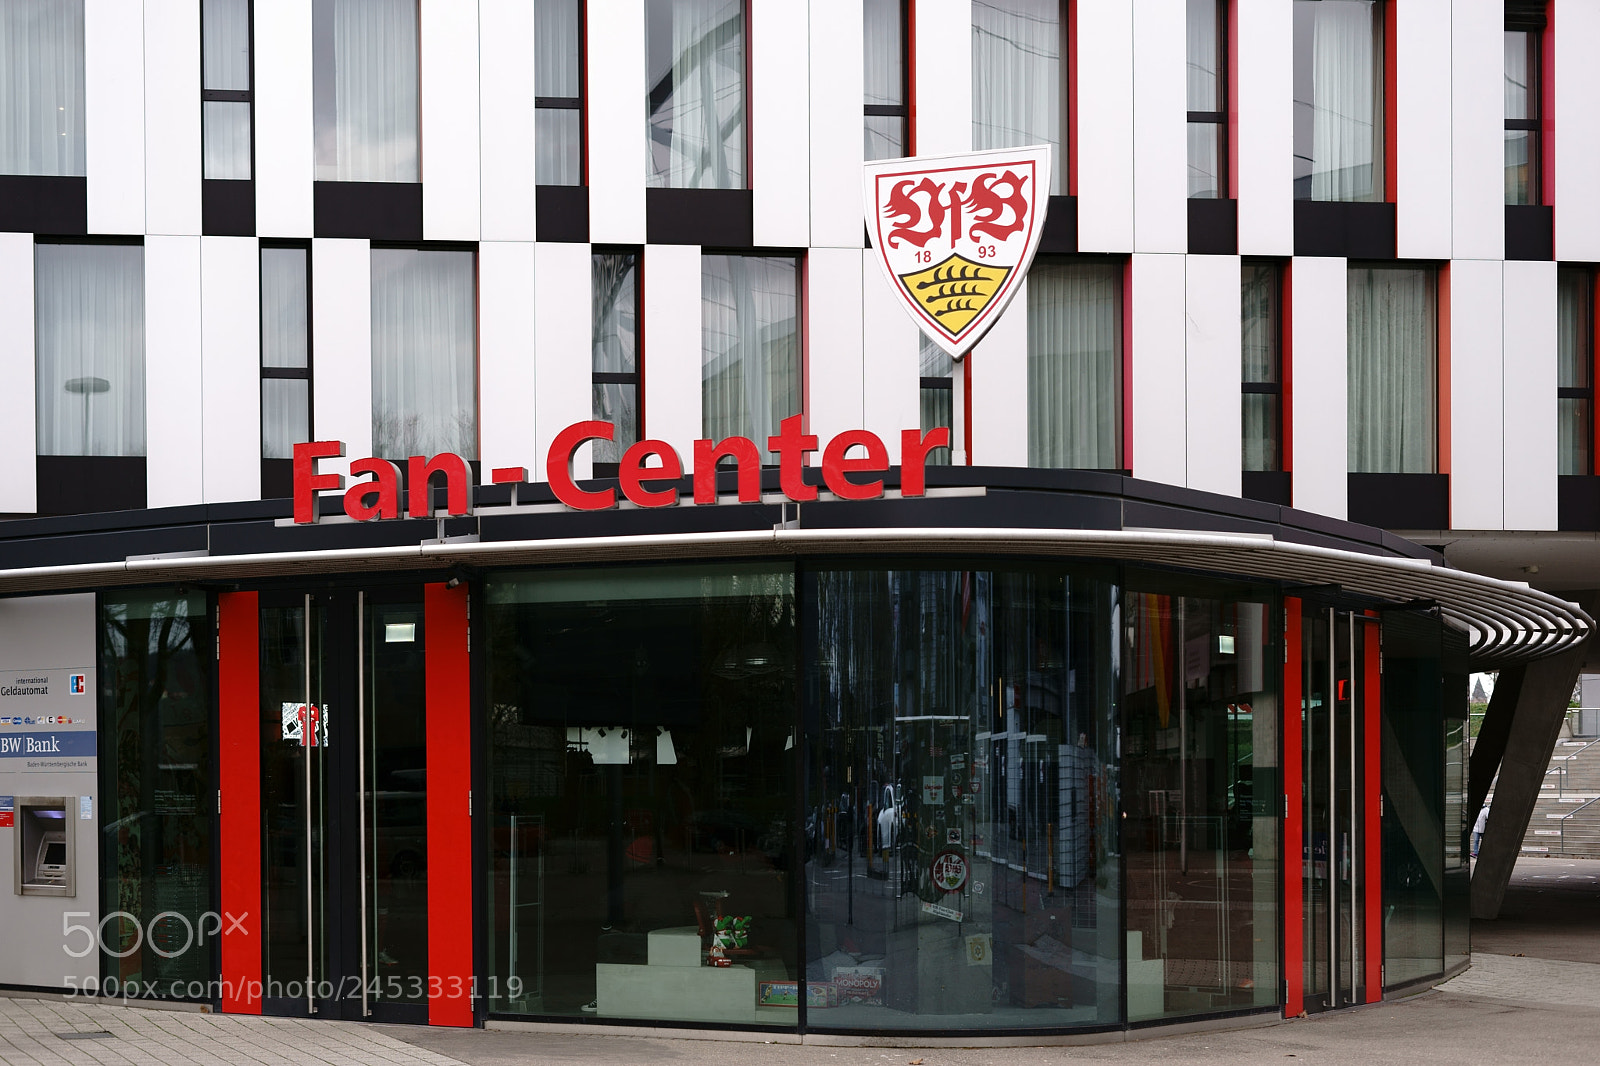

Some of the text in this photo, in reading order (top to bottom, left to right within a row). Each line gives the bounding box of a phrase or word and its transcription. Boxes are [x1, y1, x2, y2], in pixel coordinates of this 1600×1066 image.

[882, 169, 1029, 250] VfB
[914, 245, 997, 264] 18 93
[16, 677, 49, 685] international
[0, 686, 49, 697] Geldautomat
[0, 735, 61, 753] BW Bank
[836, 979, 878, 989] MONOPOLY
